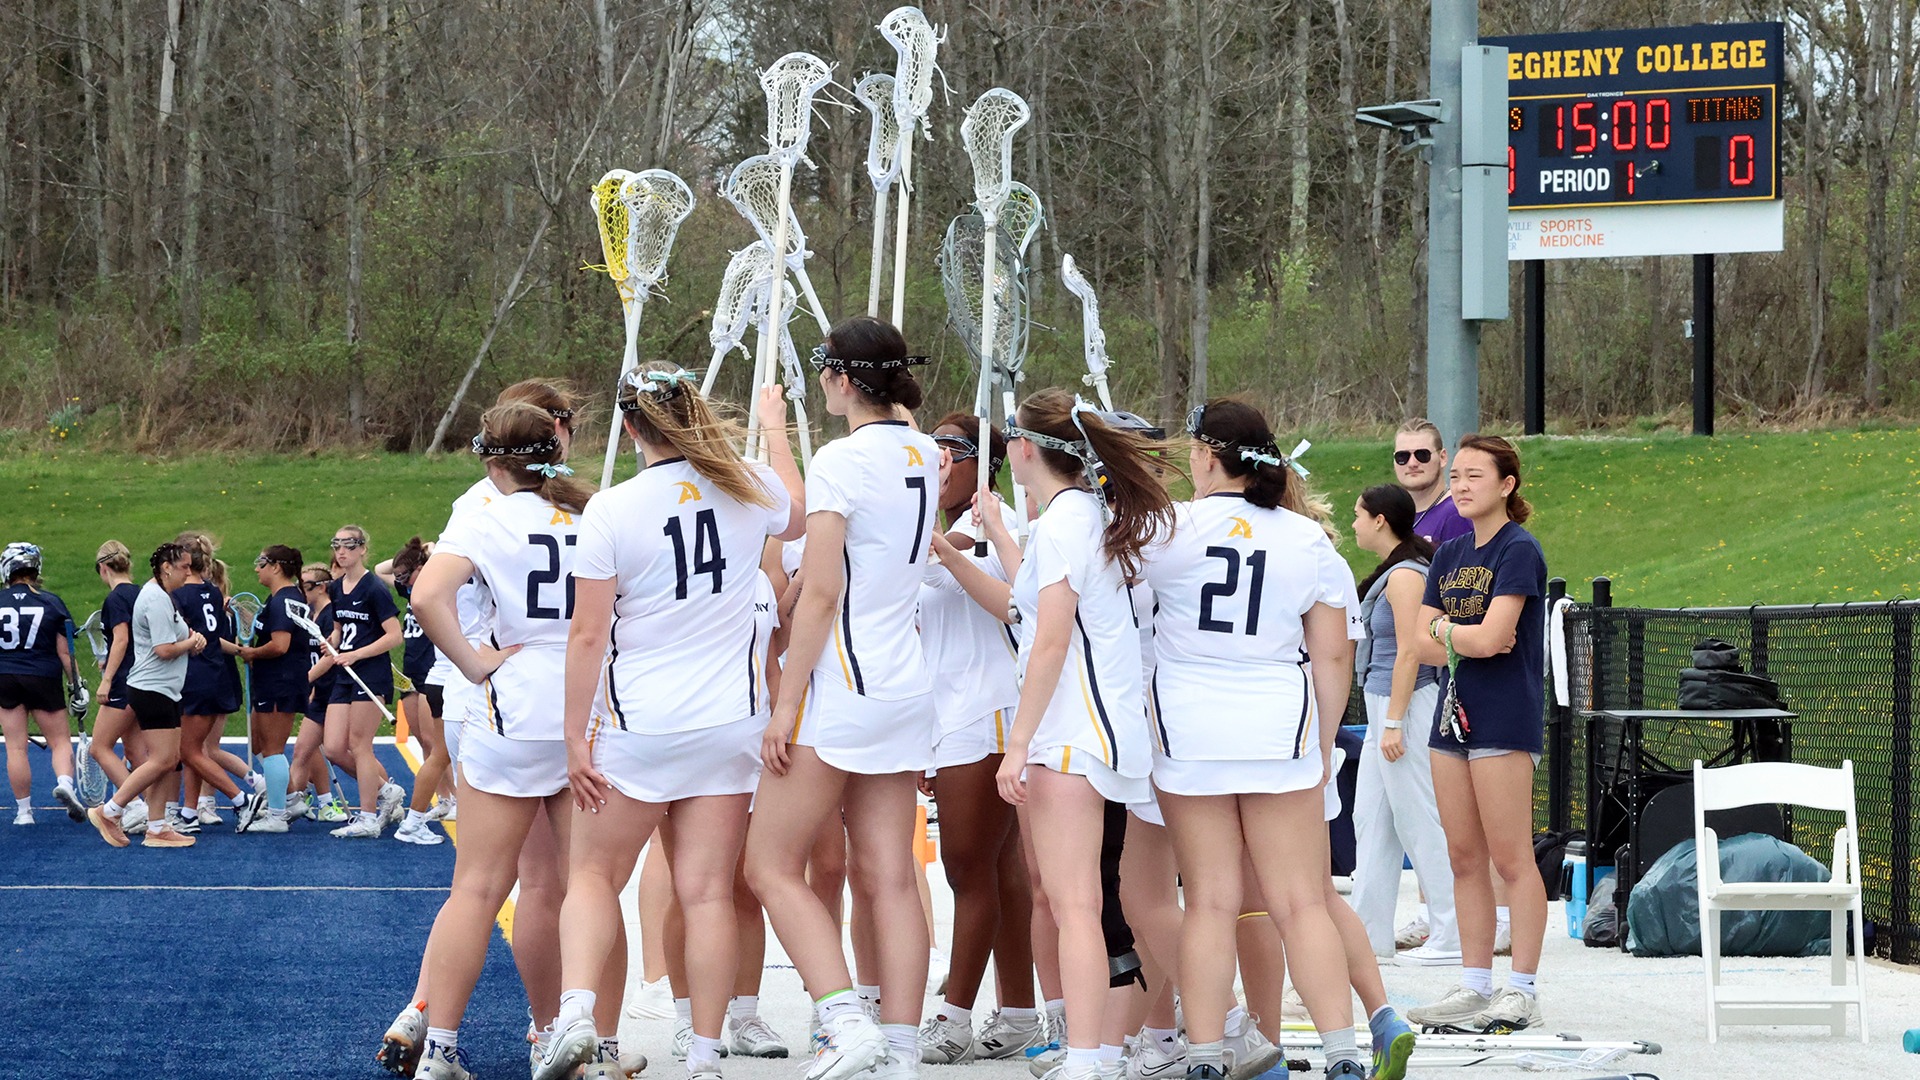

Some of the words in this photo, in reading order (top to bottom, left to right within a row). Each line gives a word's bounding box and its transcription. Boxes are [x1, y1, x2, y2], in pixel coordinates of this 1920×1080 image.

[1637, 40, 1766, 73] COLLEGE
[1687, 96, 1760, 122] TITANS
[1556, 99, 1670, 153] 15:00
[1729, 134, 1754, 185] 0
[1540, 168, 1610, 193] PERIOD
[1627, 161, 1635, 195] 1
[1539, 233, 1605, 247] MEDICINE
[1540, 219, 1592, 233] SPORTS
[825, 358, 844, 366] STX
[851, 361, 874, 369] STX
[882, 359, 903, 369] STX
[852, 377, 874, 394] STX
[1200, 433, 1227, 448] STX
[905, 476, 926, 564] 7
[663, 508, 726, 600] 14
[1198, 546, 1266, 636] 21
[0, 606, 44, 650] 37
[203, 603, 217, 632] 6
[340, 623, 357, 650] 12
